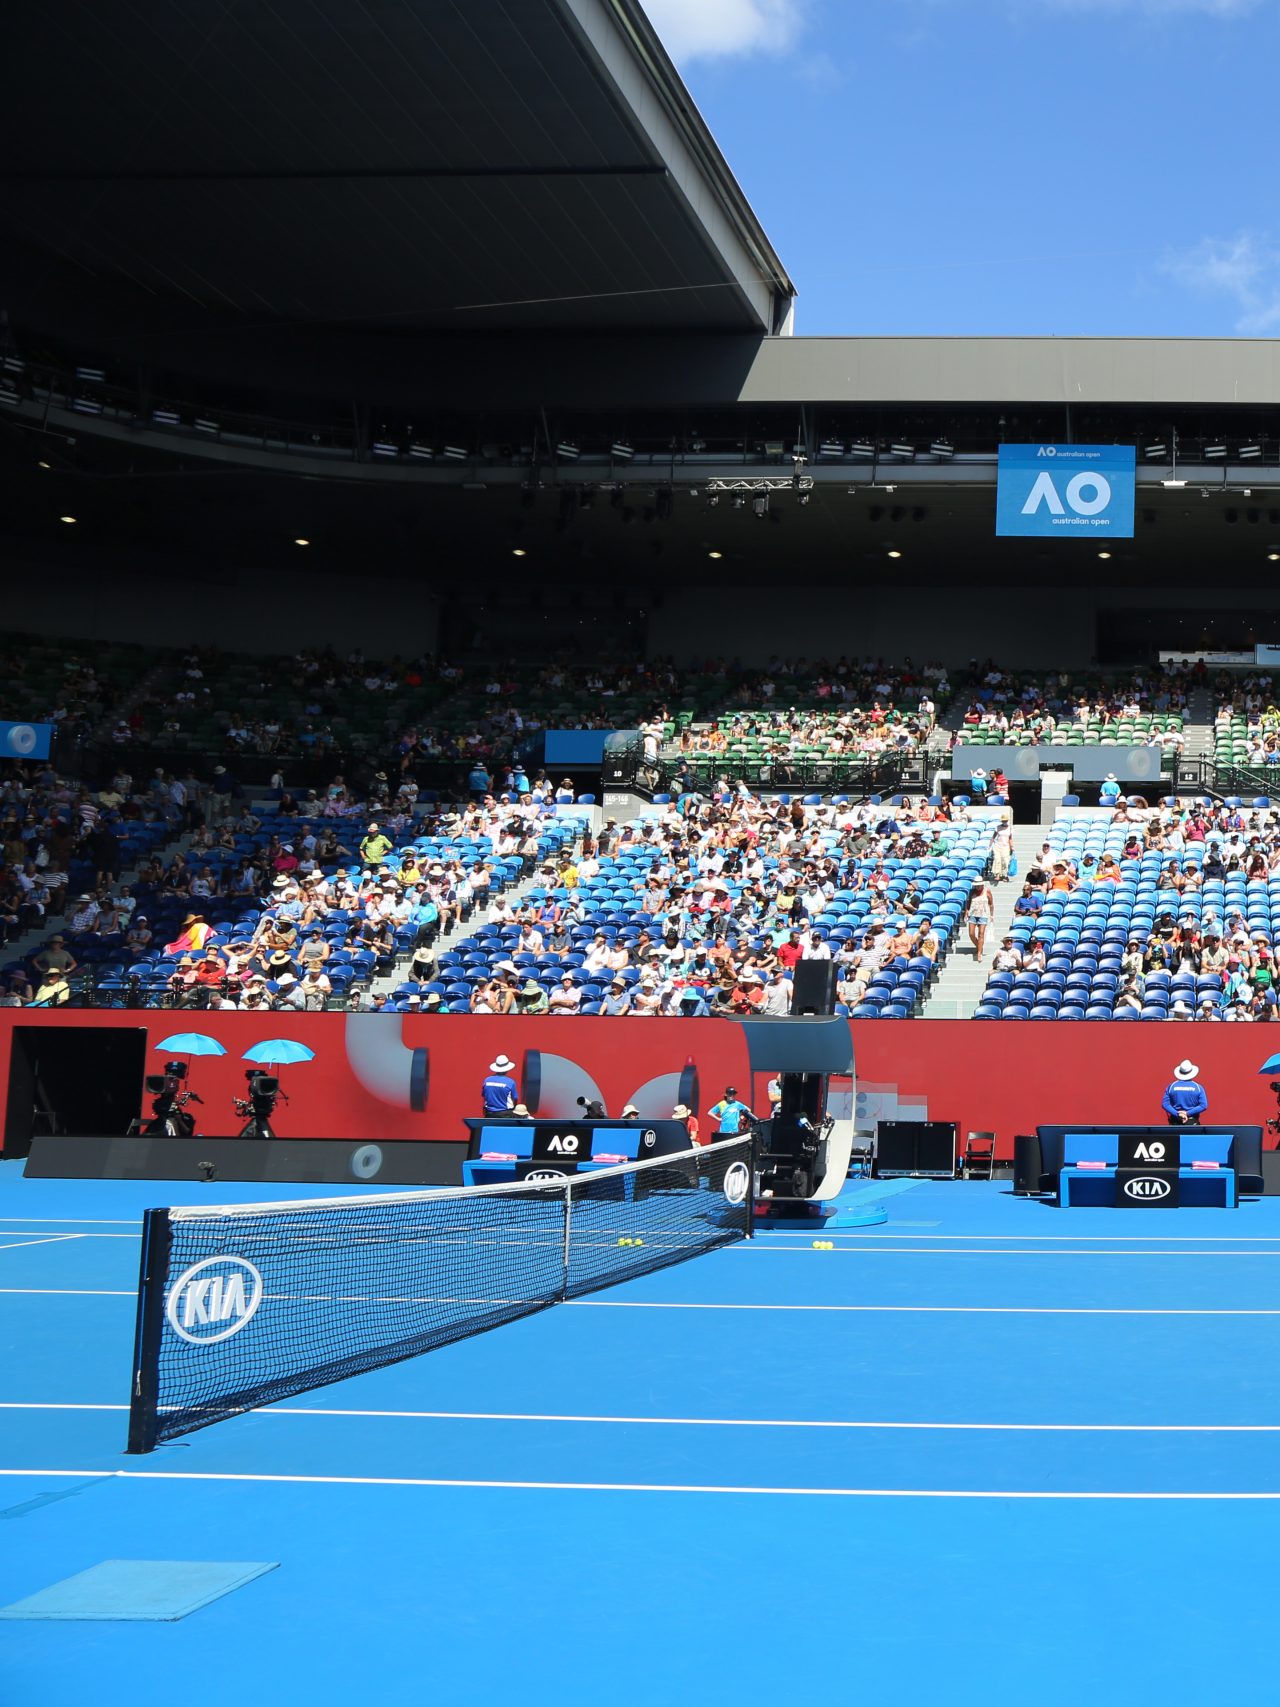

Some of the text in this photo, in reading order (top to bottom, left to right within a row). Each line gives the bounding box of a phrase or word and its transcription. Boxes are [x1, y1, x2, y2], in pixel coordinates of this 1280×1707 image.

[1037, 446, 1056, 457] AO
[1056, 450, 1085, 458] australian
[1021, 471, 1111, 516] AO
[1052, 517, 1110, 526] australian open
[901, 772, 910, 780] 11
[1184, 773, 1194, 781] 12
[547, 1134, 579, 1152] AO
[1133, 1141, 1166, 1159] AO
[1132, 1181, 1163, 1195] KIA
[184, 1273, 246, 1328] KIA
